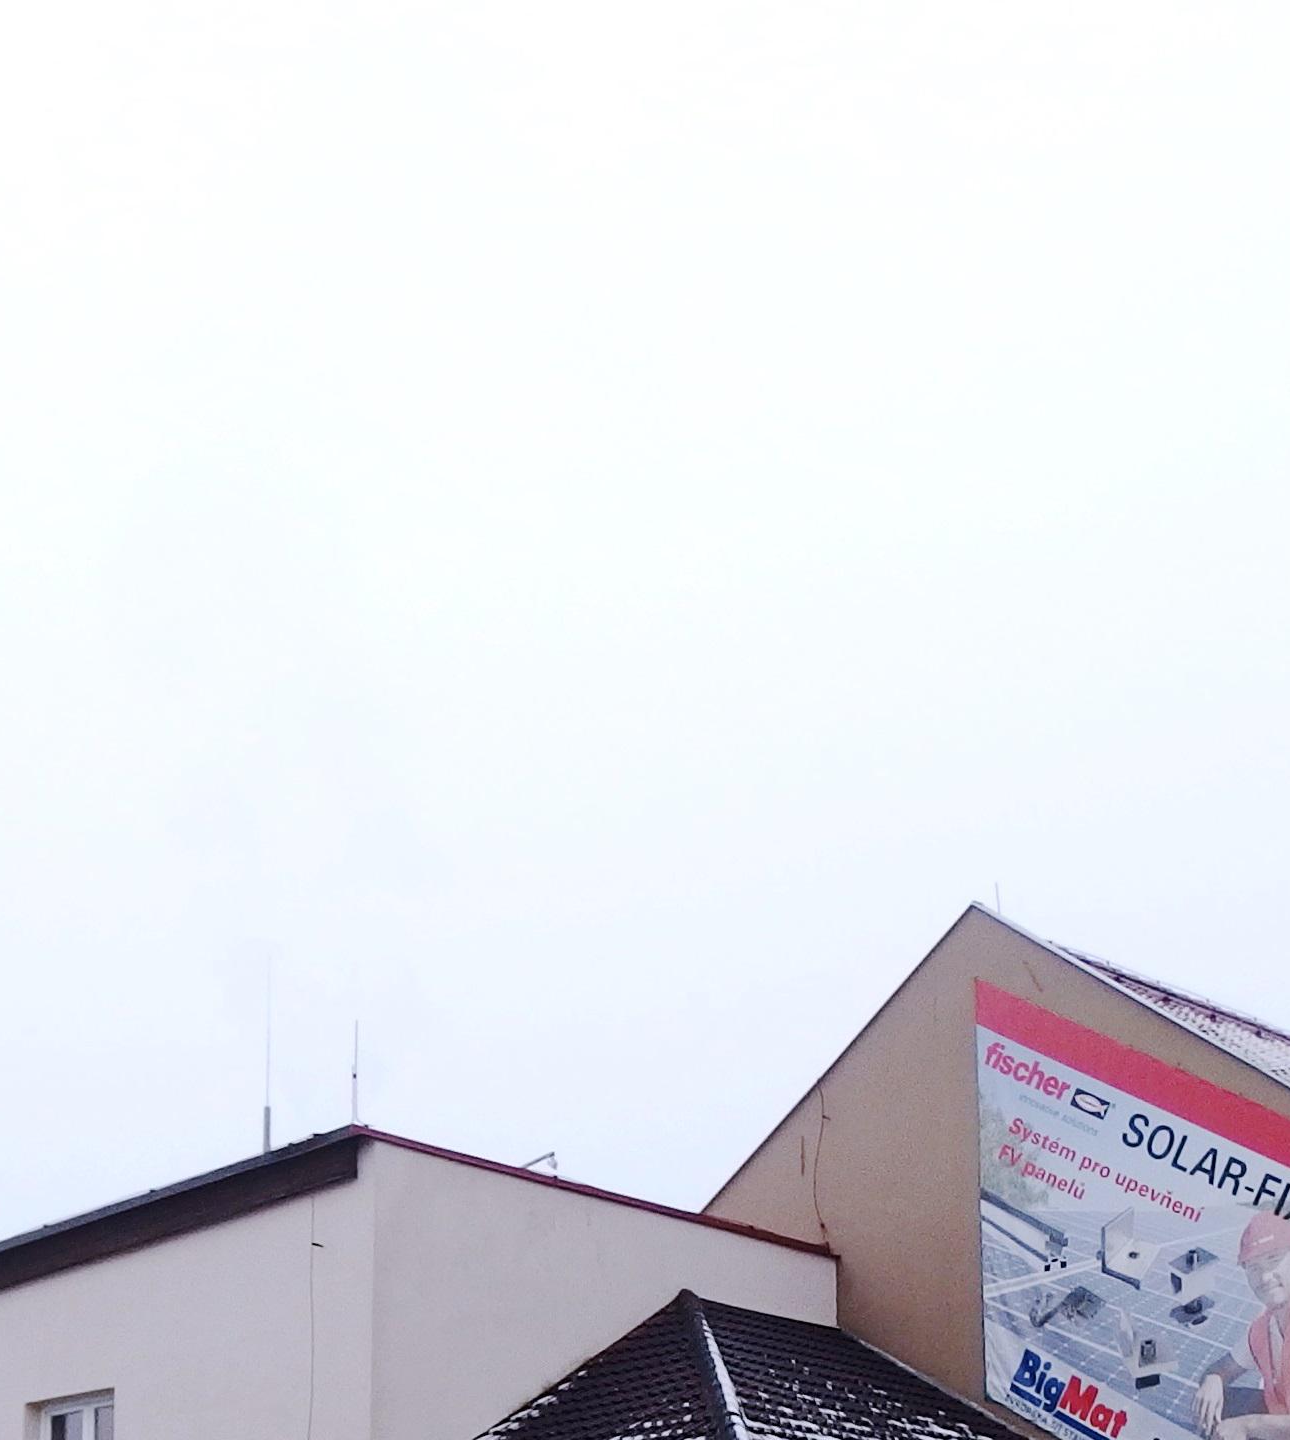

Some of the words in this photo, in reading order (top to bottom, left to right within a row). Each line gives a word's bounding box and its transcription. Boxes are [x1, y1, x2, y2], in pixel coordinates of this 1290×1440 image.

[985, 1042, 1071, 1100] fischer
[998, 1144, 1023, 1167] FV
[1009, 1117, 1077, 1162] Systém
[1078, 1155, 1111, 1178] pro
[1013, 1348, 1128, 1439] BigMat
